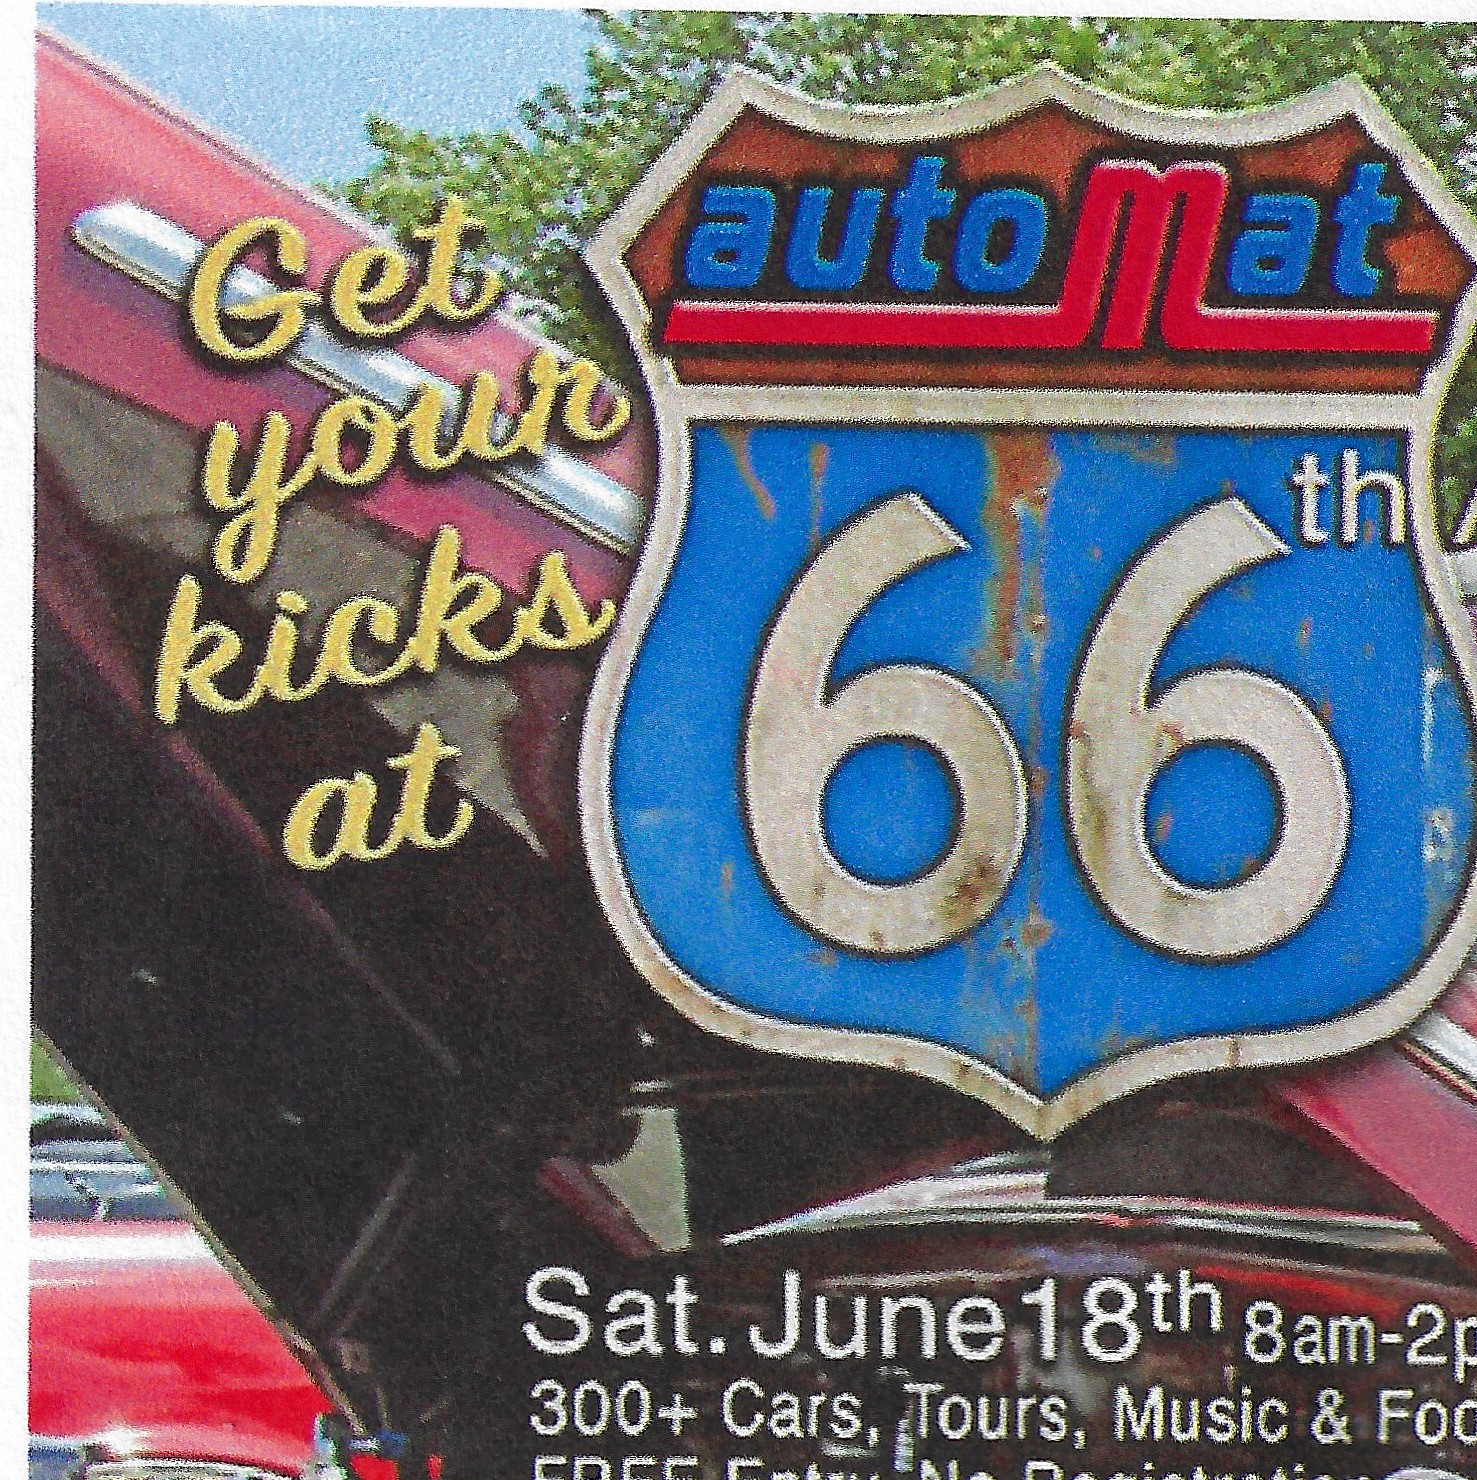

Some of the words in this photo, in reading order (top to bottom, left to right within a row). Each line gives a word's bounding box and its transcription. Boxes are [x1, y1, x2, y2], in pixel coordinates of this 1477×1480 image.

[188, 200, 501, 360] Get
[203, 354, 630, 584] your
[153, 526, 615, 723] kicks
[281, 726, 473, 871] at
[521, 1267, 726, 1356] Sat.
[750, 1270, 1006, 1359] June
[530, 1379, 697, 1436] 300+
[722, 1378, 878, 1447] Cars,
[903, 1382, 1086, 1449] Tours,
[1115, 1385, 1288, 1442] Music
[1311, 1388, 1352, 1445] &
